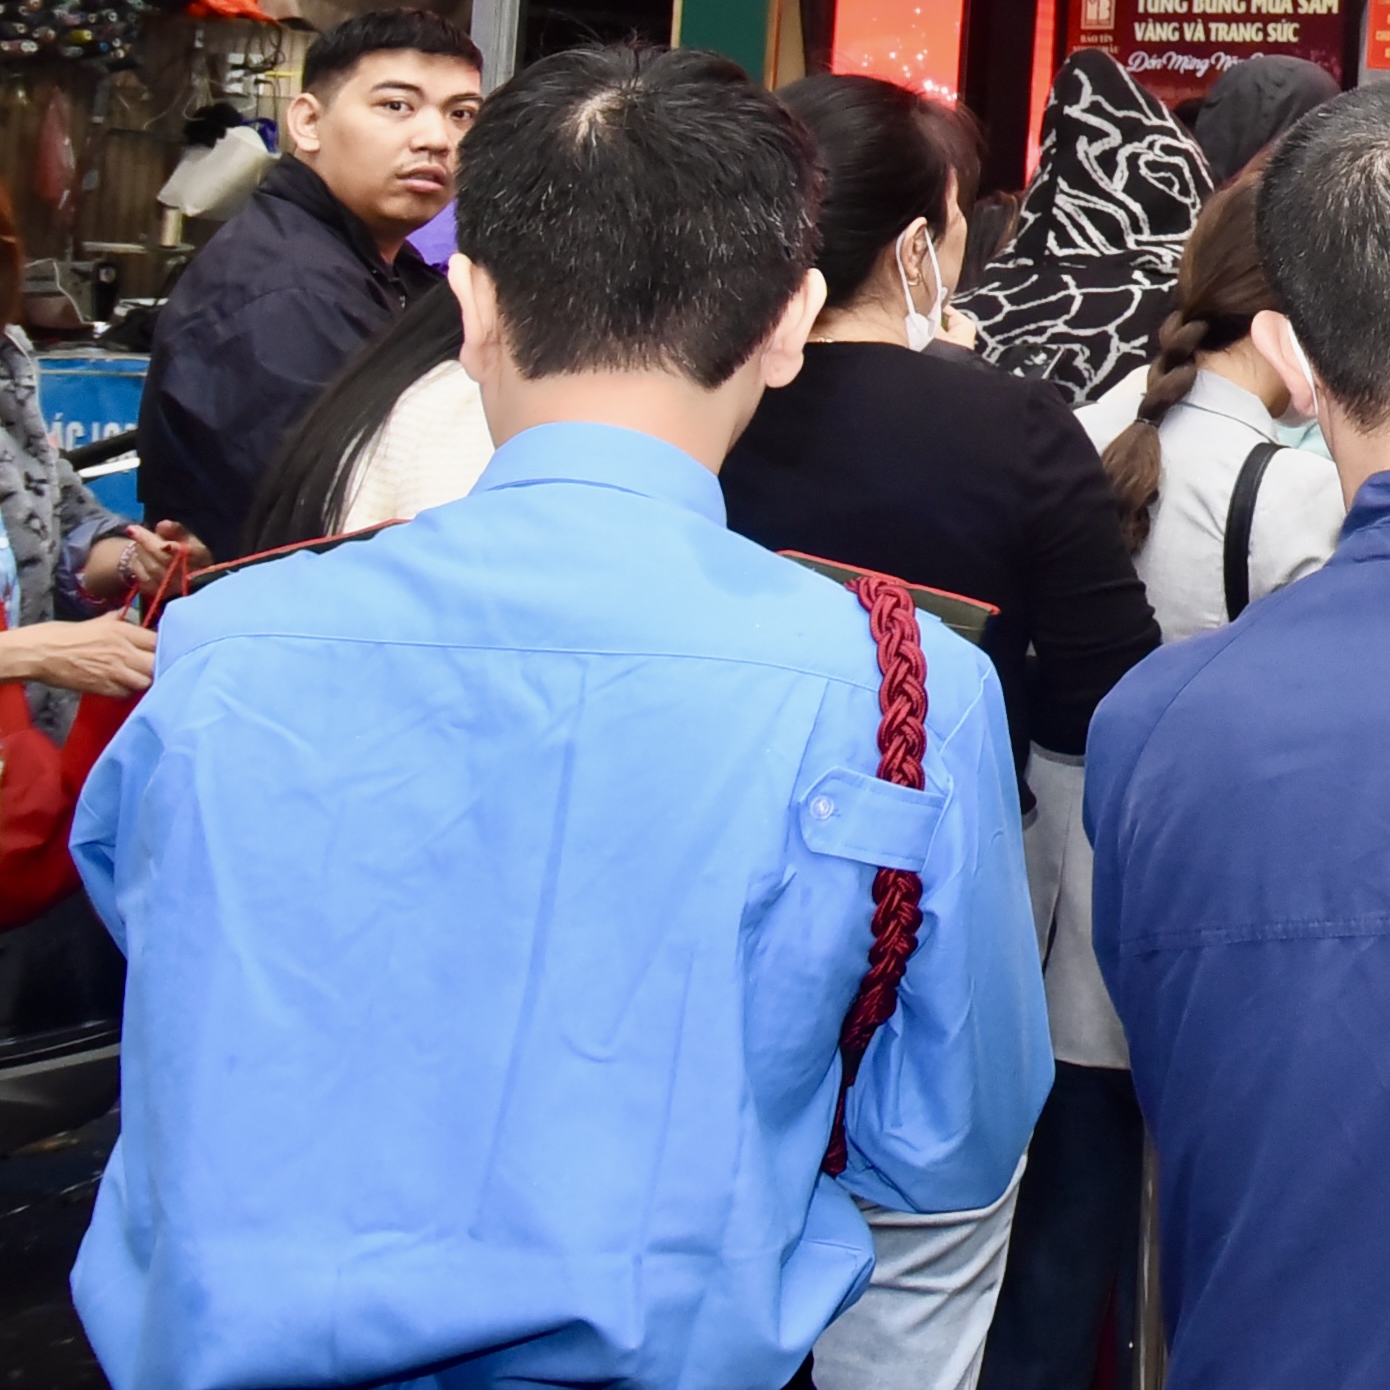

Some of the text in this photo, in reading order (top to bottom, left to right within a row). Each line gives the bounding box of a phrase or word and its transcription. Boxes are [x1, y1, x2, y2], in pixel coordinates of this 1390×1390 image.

[1133, 18, 1300, 43] VÀNG VÀ TRANG SỨC
